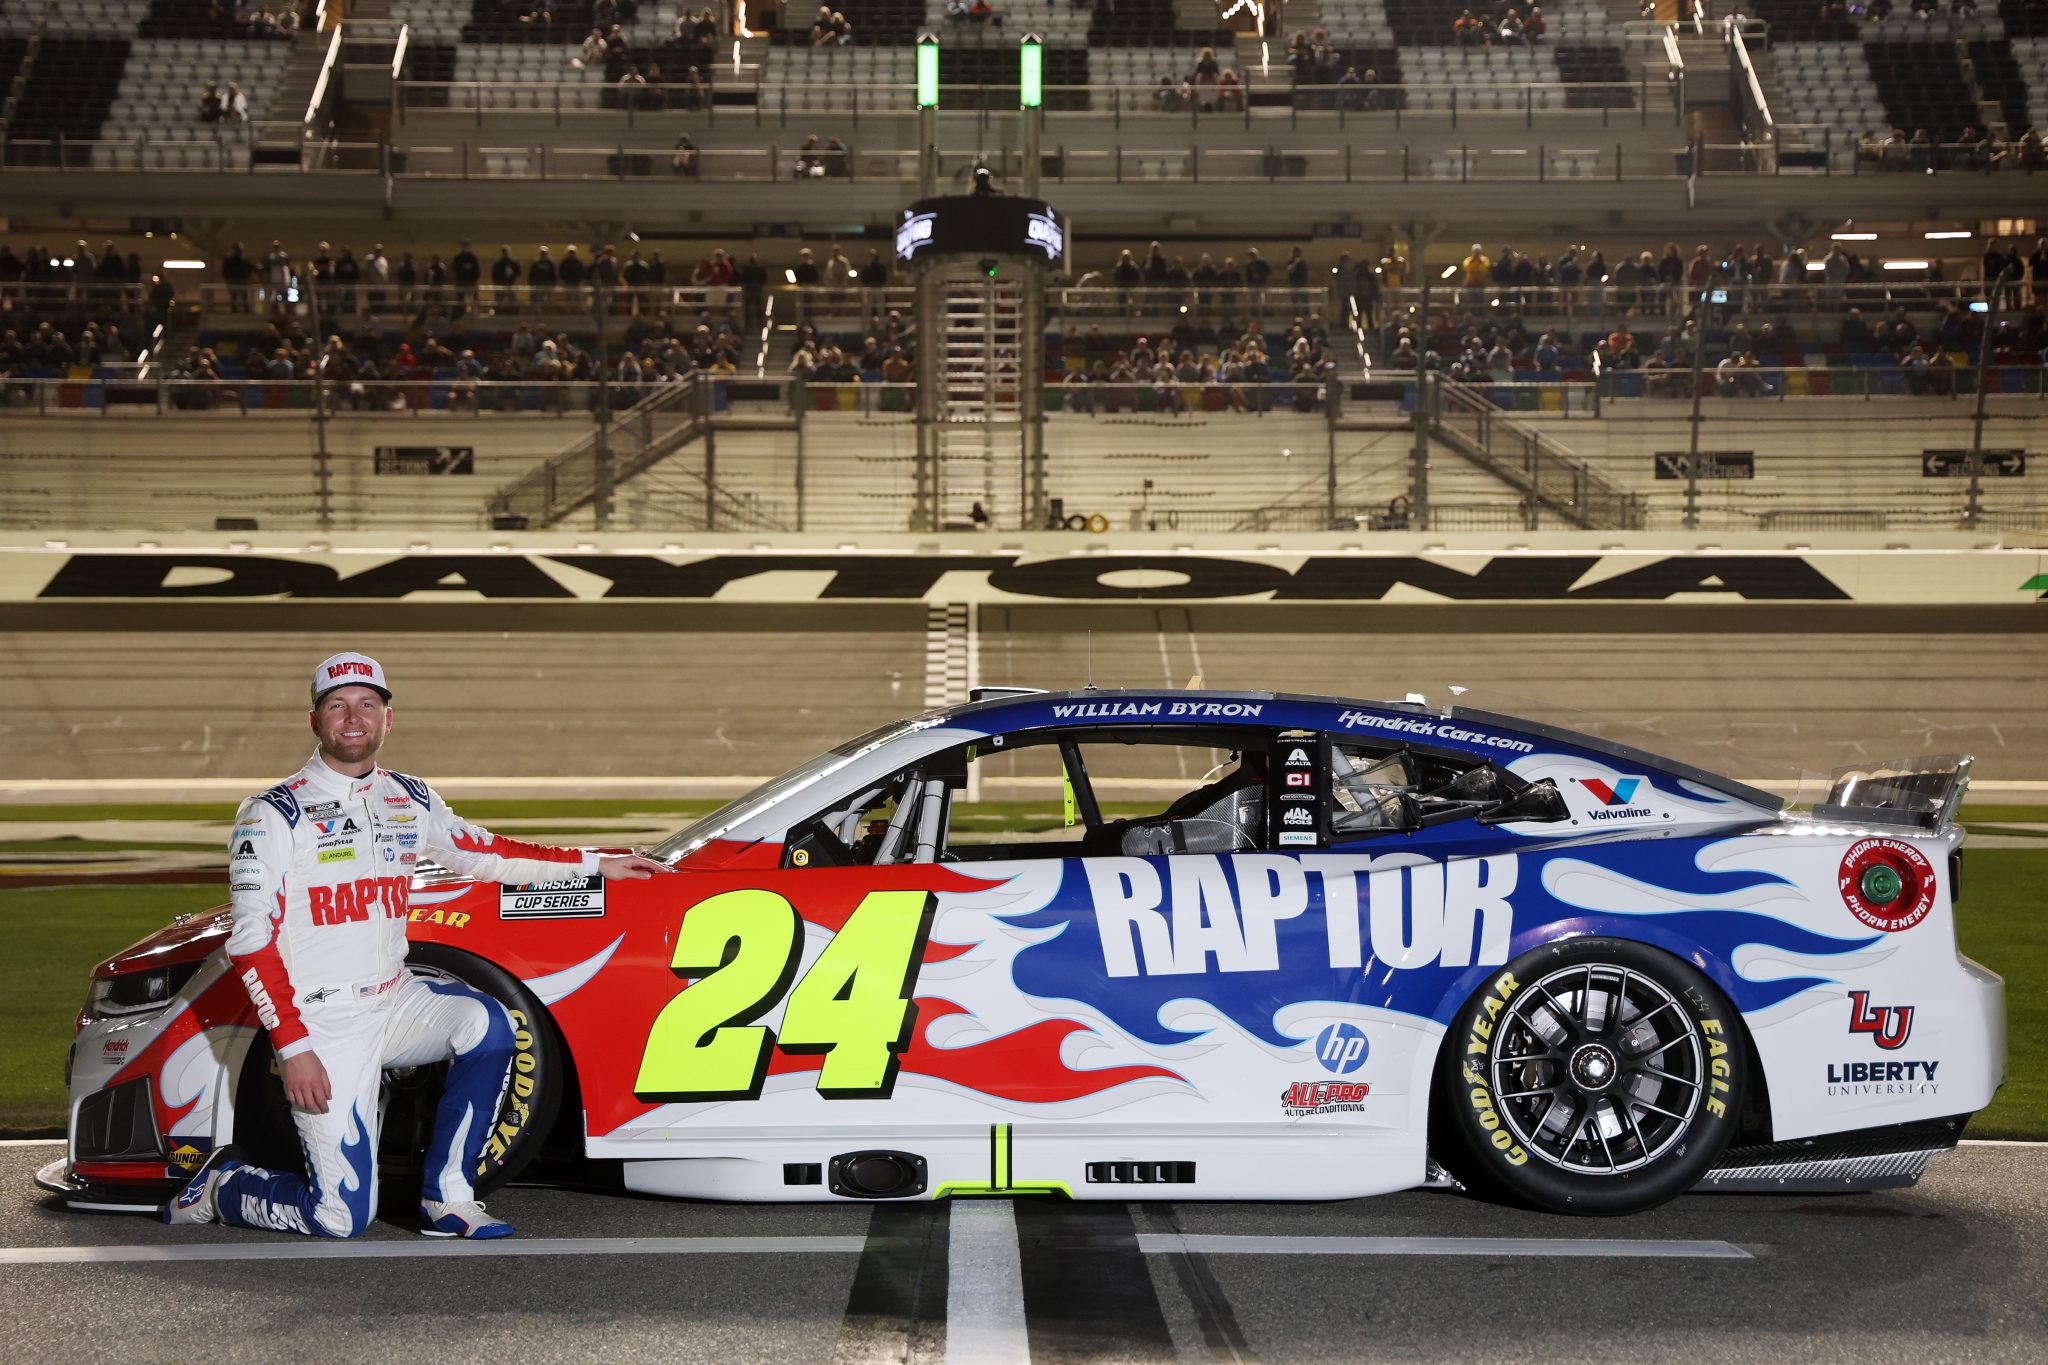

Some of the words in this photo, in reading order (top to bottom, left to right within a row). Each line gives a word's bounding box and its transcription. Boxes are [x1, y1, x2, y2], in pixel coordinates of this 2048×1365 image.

[37, 553, 1854, 601] DAYTONA
[327, 662, 374, 679] RAPTOR
[1053, 702, 1162, 718] WILLIAM
[1168, 702, 1263, 717] BYRON
[1286, 773, 1310, 786] CI
[1283, 807, 1313, 820] MAC
[1587, 808, 1652, 820] Valvoline
[241, 829, 266, 837] Atrium
[328, 850, 354, 860] ANDURIL
[1845, 839, 1880, 869] PHORM
[1882, 840, 1928, 868] ENERGY
[514, 896, 542, 909] CUP
[543, 894, 590, 908] SERIES
[1846, 894, 1888, 929] PHORM
[1890, 892, 1931, 930] ENERGY
[1081, 853, 1518, 978] RAPTOR
[633, 889, 938, 1103] 24
[1847, 990, 1915, 1050] LU
[1318, 1023, 1368, 1074] hp
[1463, 971, 1528, 1166] GOODYEAR
[1700, 1019, 1731, 1119] EAGLE
[1828, 1061, 1939, 1083] LIBERTY
[1282, 1082, 1370, 1108] ALL-PRO
[1828, 1083, 1939, 1097] UNIVERSITY
[1284, 1109, 1304, 1117] AUTO
[1305, 1104, 1365, 1116] RECONDITIONING
